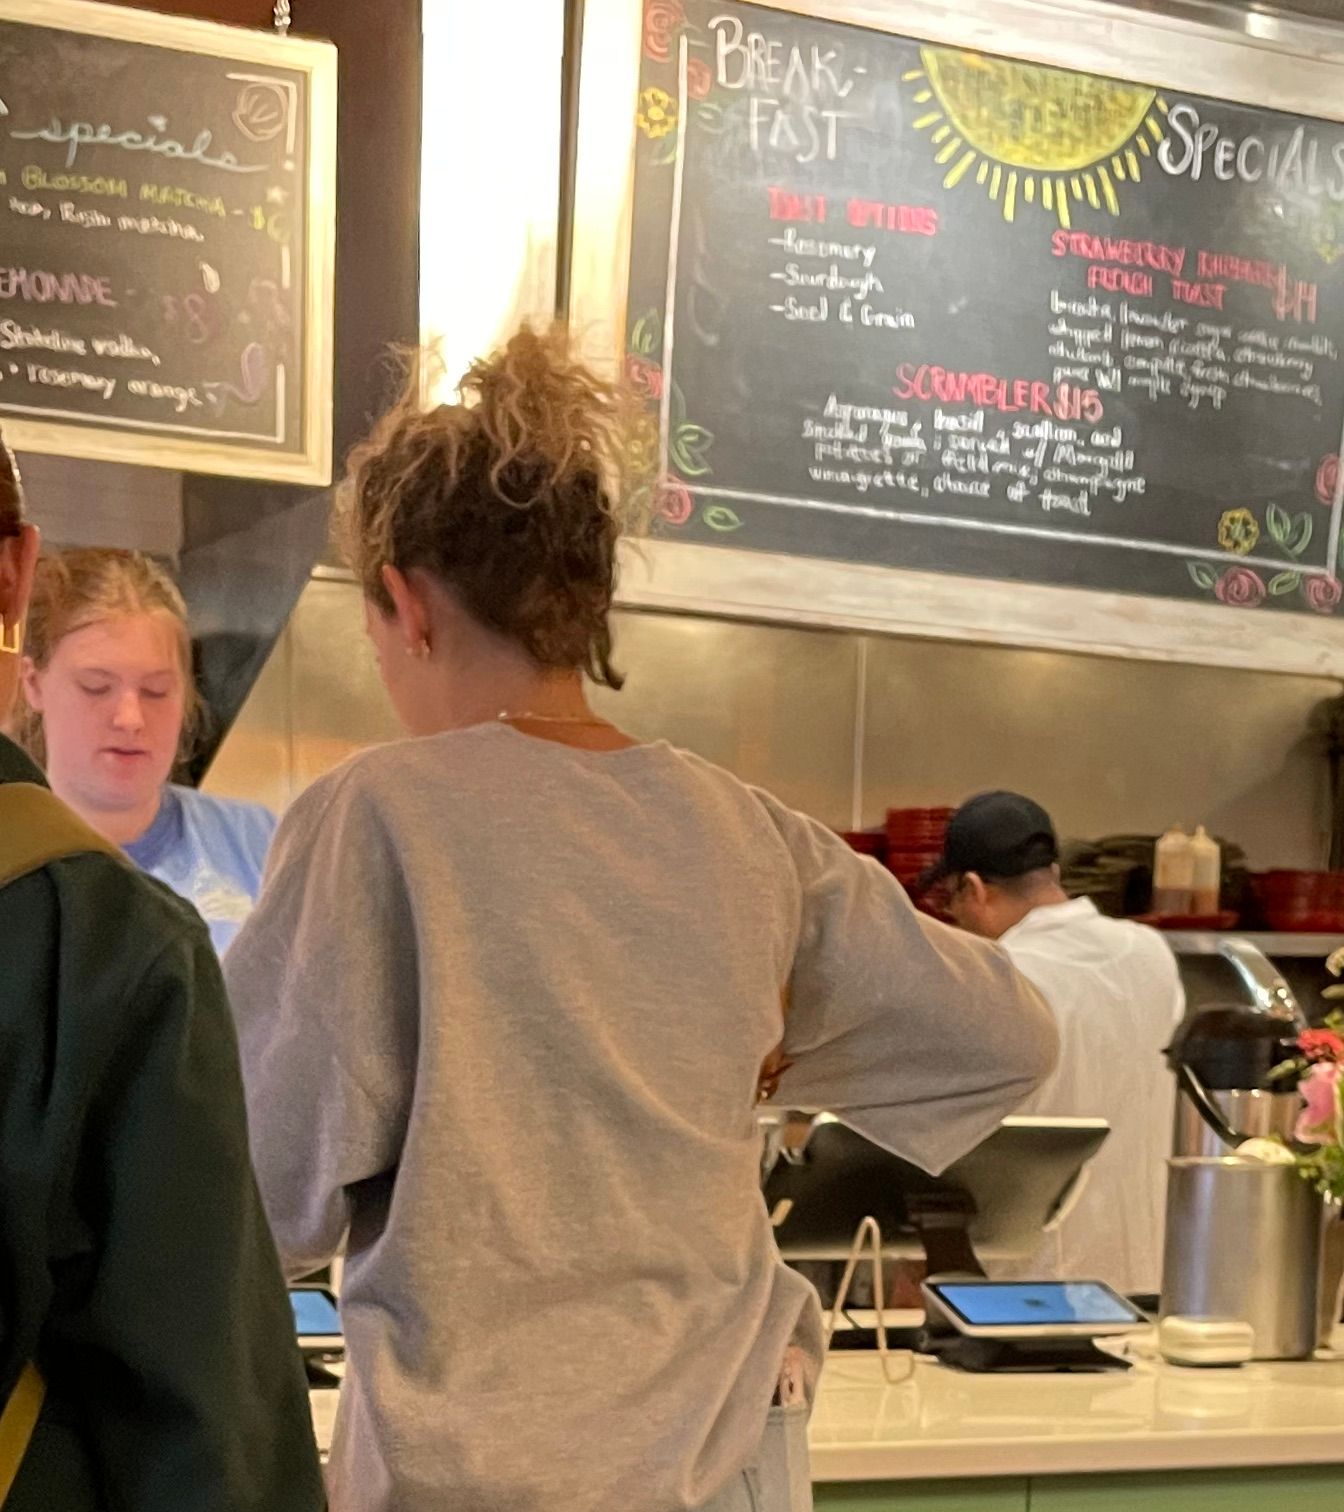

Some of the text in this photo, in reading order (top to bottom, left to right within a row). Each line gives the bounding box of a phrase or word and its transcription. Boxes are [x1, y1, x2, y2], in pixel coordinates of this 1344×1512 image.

[10, 114, 270, 173] specials
[749, 97, 857, 163] FAST
[22, 165, 128, 198] BLOSSOM
[139, 183, 226, 218] MATCHA
[847, 198, 939, 236] OPTIONS
[1051, 229, 1186, 276] STRAWBERRY
[1171, 278, 1228, 311] TOAST
[860, 303, 915, 329] Grain
[27, 363, 116, 400] rosemary
[892, 363, 1105, 424] SCRAMBLER $15
[801, 418, 869, 444] Smoked
[1090, 425, 1123, 449] and
